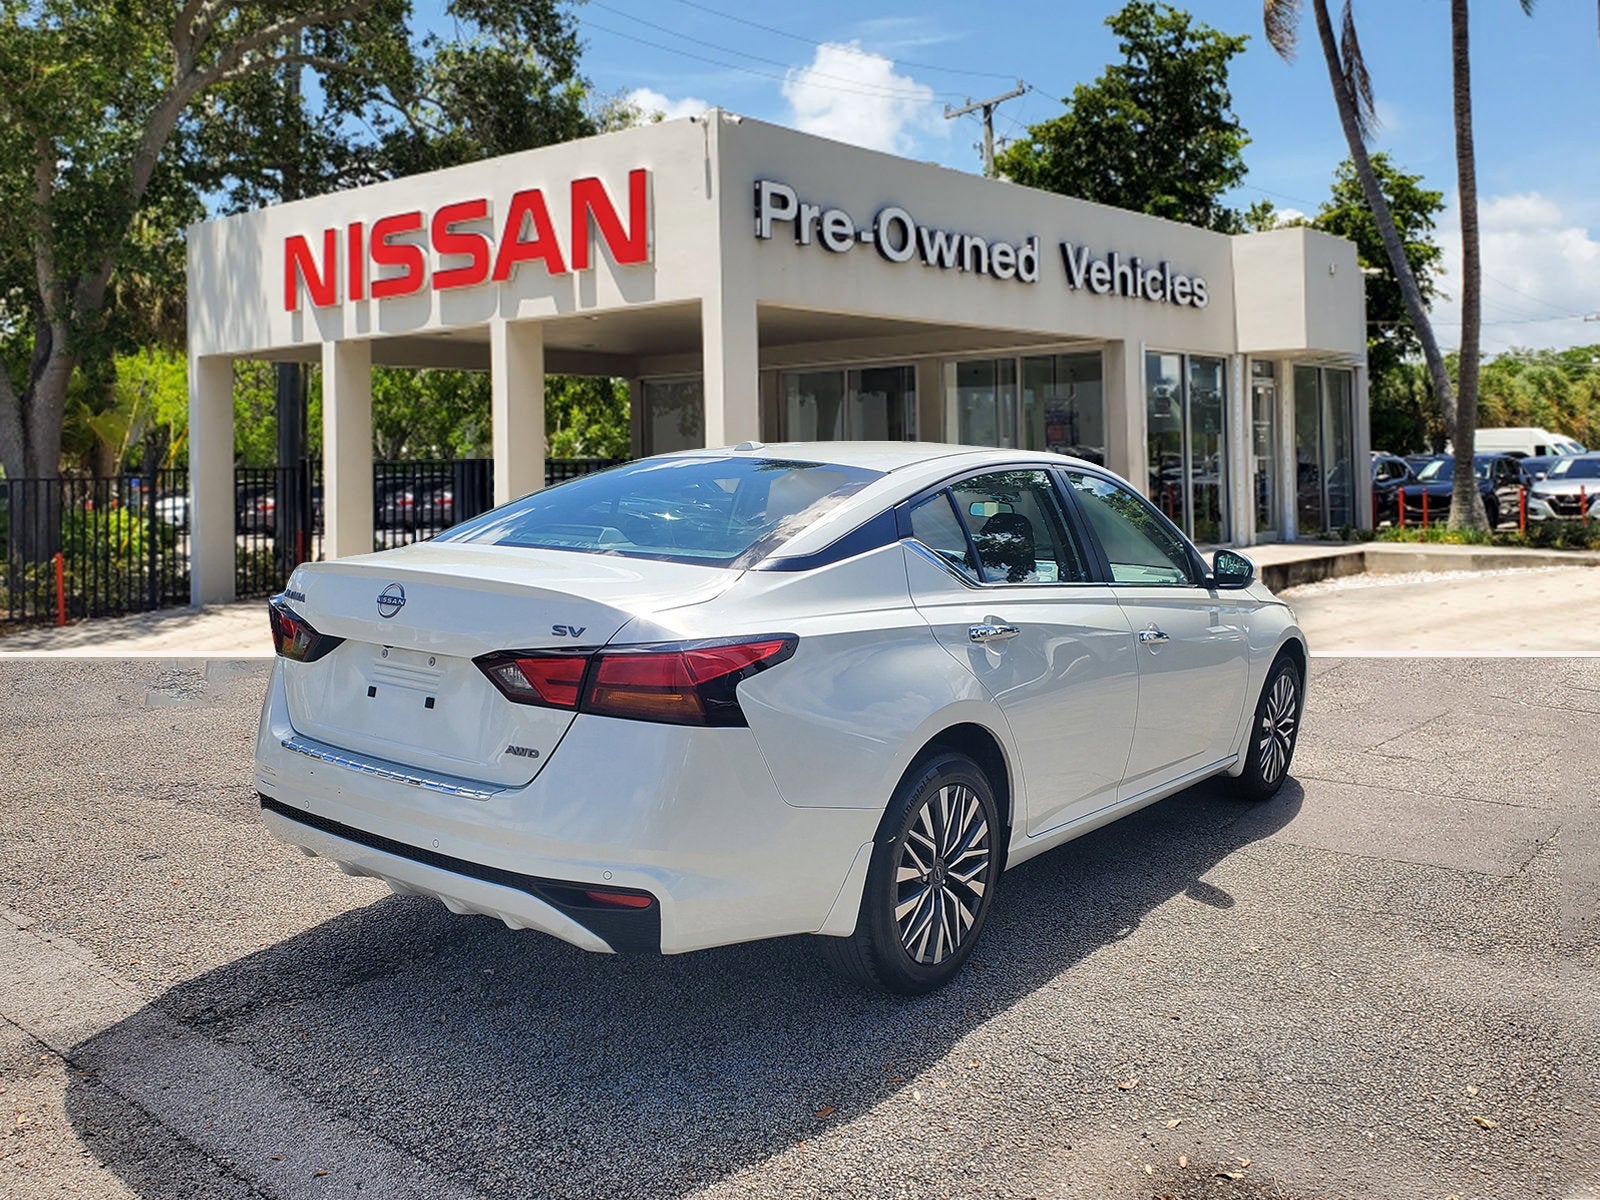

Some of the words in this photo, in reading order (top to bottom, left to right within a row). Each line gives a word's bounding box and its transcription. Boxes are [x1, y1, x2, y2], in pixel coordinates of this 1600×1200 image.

[285, 168, 648, 312] NISSAN
[755, 180, 1040, 284] Pre-Owned
[1060, 242, 1209, 308] Vehicles
[551, 625, 586, 638] SV
[505, 745, 539, 758] AWD
